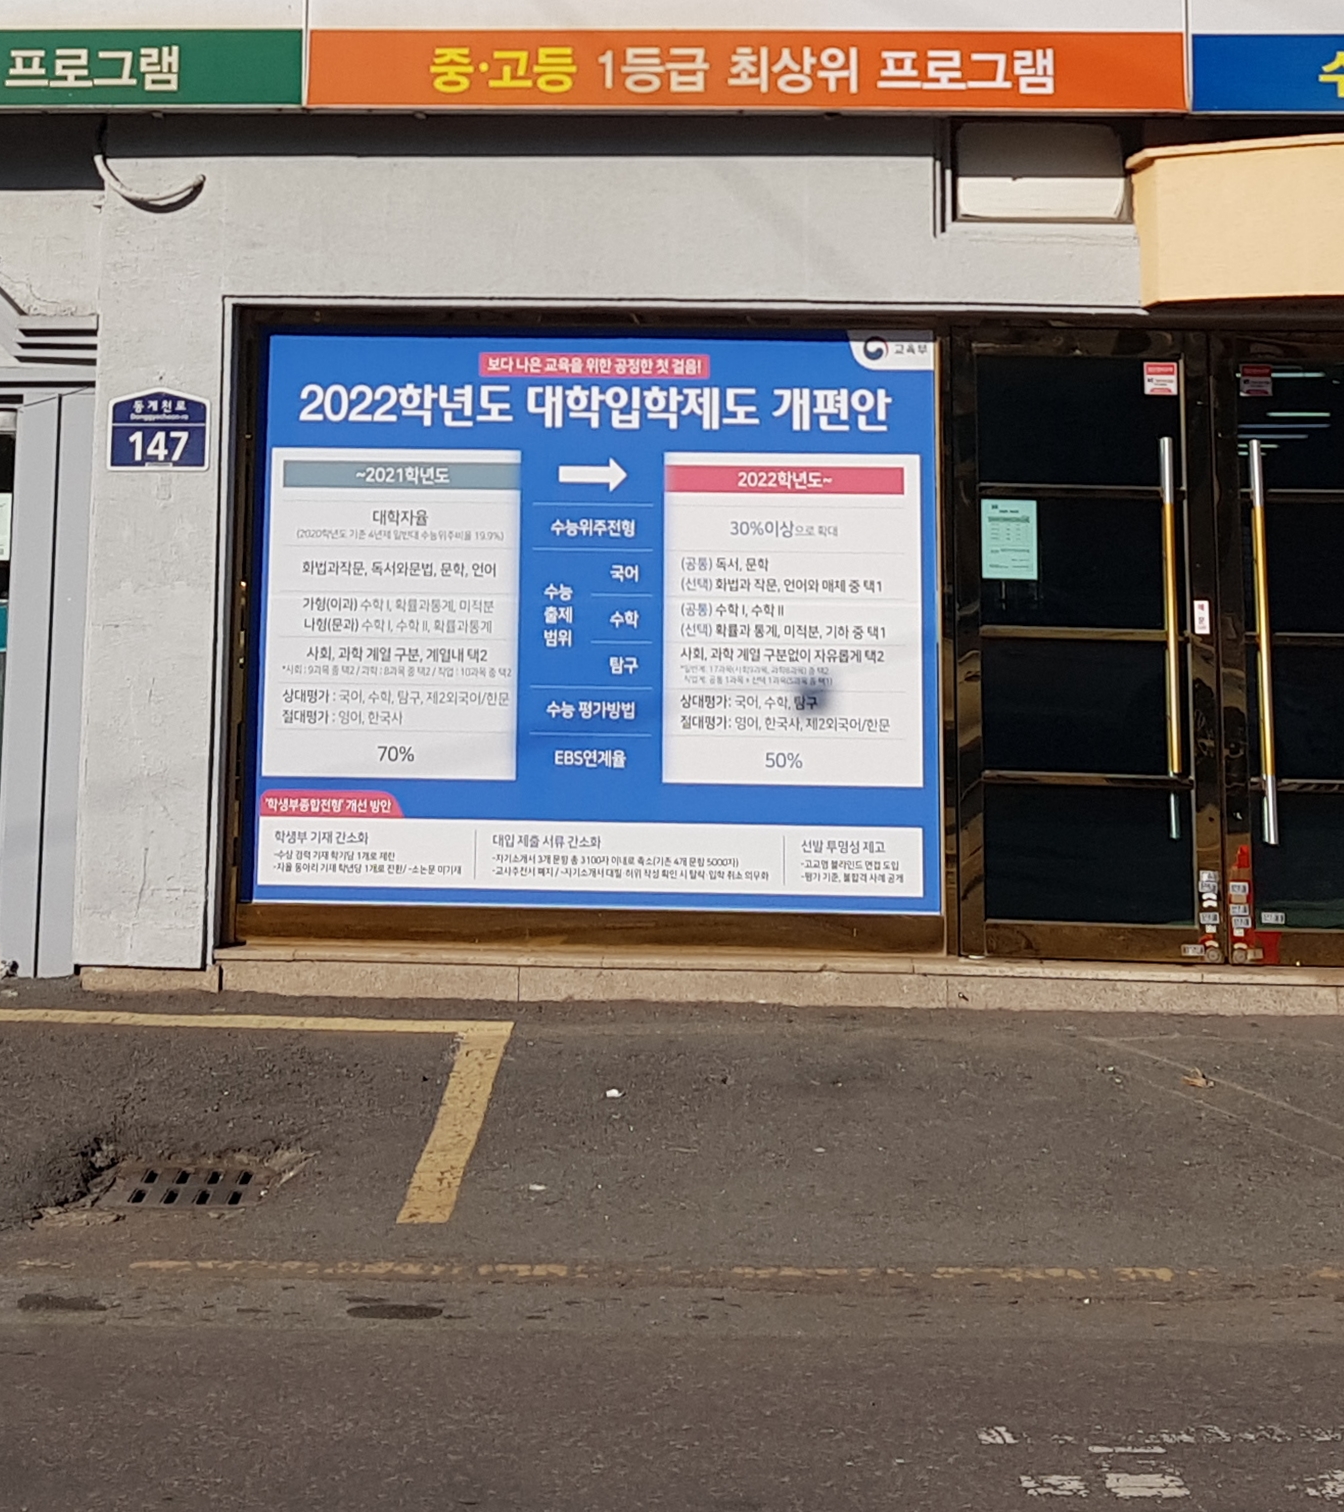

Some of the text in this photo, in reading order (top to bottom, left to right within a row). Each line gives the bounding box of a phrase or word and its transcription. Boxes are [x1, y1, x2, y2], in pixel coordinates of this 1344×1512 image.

[4, 44, 180, 92] 프로그램
[430, 46, 1055, 95] 중·고등 1등급 최상위 프로그램
[894, 344, 928, 356] 교육부
[487, 358, 701, 375] 보다 나은 교육을 위한 공정한 첫 걸음!
[133, 400, 186, 413] 동계천로
[299, 383, 892, 431] 2022학년도 대학입학제도 개편안
[129, 431, 189, 461] 147
[356, 467, 450, 484] ~2021학년도
[737, 471, 833, 489] 2022학년도~
[372, 510, 428, 526] 대학자율
[551, 519, 635, 537] 수능위주전형
[302, 561, 496, 577] 화법과작문, 독서와문법, 문학, 언어
[681, 557, 768, 571] (공통) 독서, 문학
[610, 565, 639, 582] 국어
[544, 584, 573, 600] 수능
[681, 578, 882, 593] (선택) 화법과 작문, 언어와 매체 중 택1
[544, 607, 573, 624] 출제
[610, 611, 639, 628] 수학
[544, 630, 572, 647] 범위
[610, 657, 638, 674] 탐구
[546, 701, 635, 719] 수능 평가방법
[681, 715, 890, 732] 절대평가: 영어, 한국사, 제2외국어/한문
[377, 746, 415, 762] 70%
[554, 750, 626, 768] EBS연계율
[765, 752, 803, 769] 50%
[346, 799, 367, 812] 개선
[370, 799, 391, 813] 방안
[275, 831, 369, 845] 학생부 기재 간소화
[492, 835, 601, 849] 대입 제출 서류 간소화
[801, 840, 885, 854] 선발 투명성 제고
